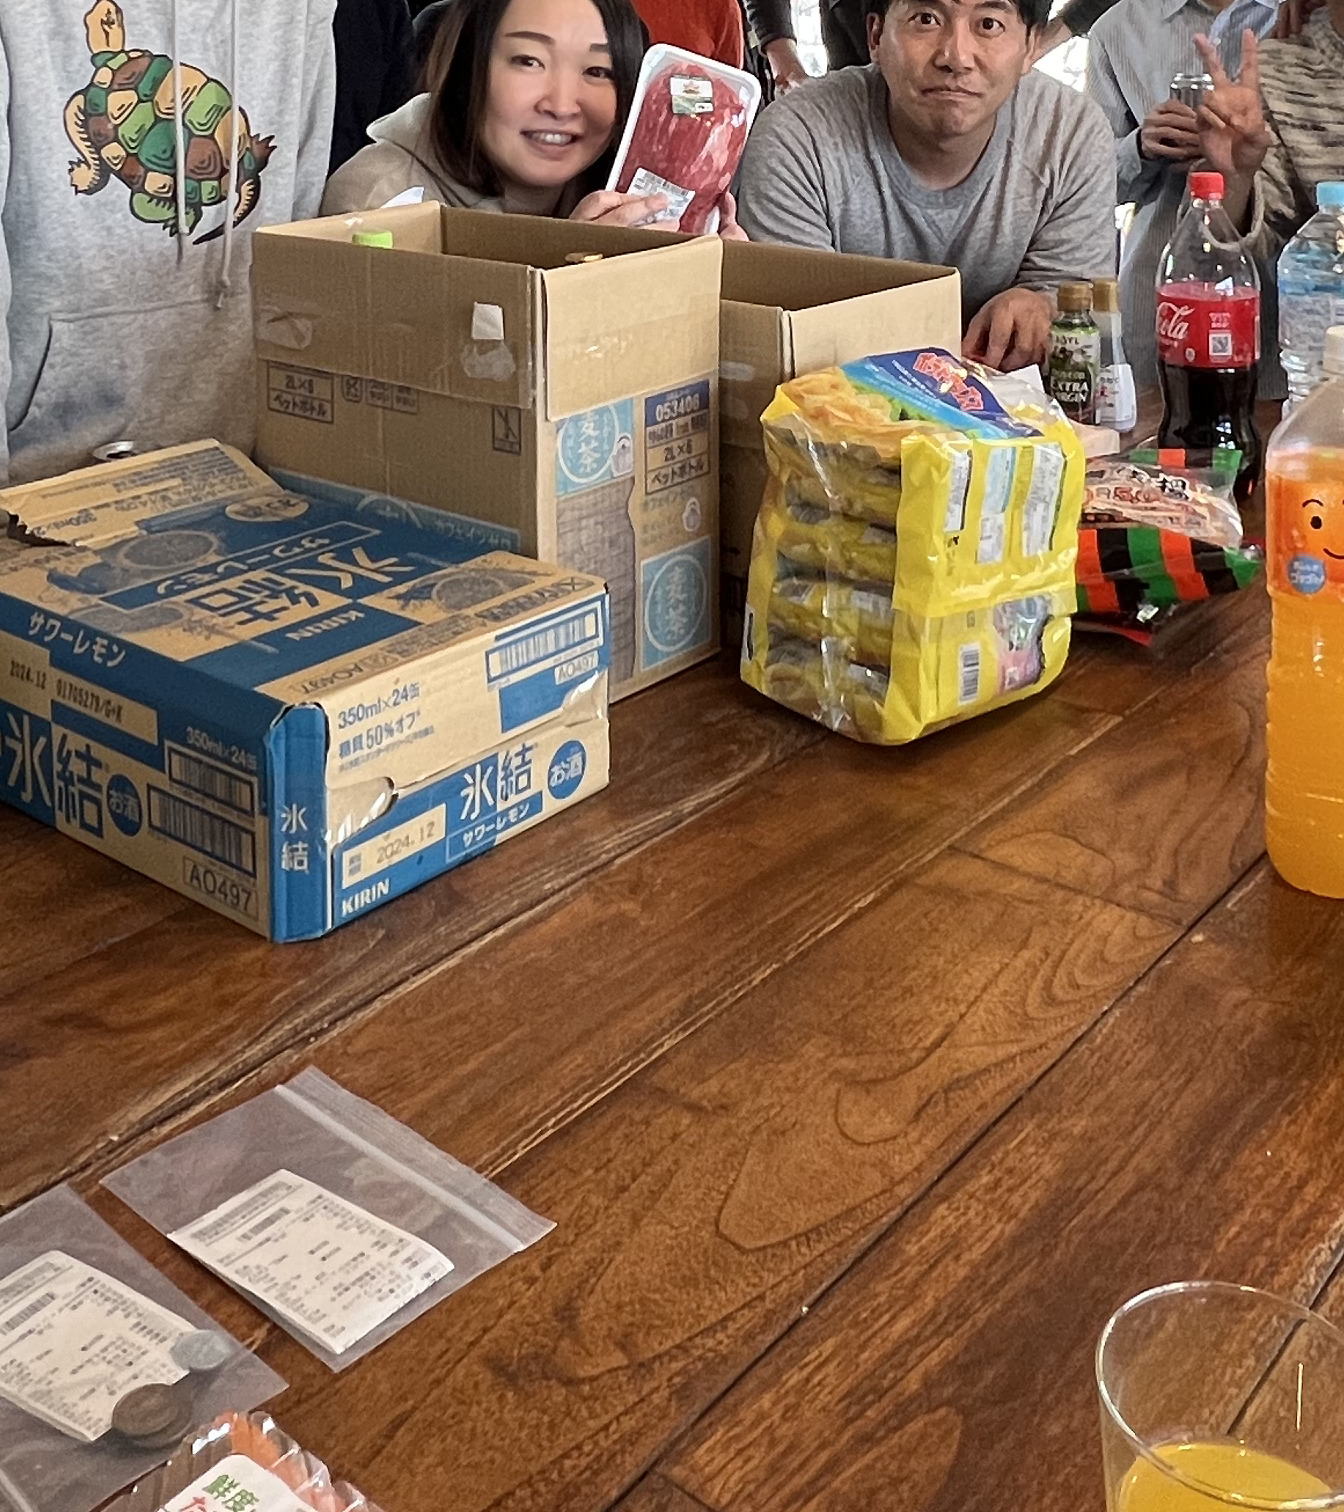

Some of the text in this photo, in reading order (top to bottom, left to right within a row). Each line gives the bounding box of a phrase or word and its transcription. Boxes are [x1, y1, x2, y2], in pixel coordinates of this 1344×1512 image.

[28, 611, 127, 668] サワーレモン
[6, 711, 105, 839] 氷結
[459, 741, 533, 821] 氷結
[549, 752, 584, 787] お酒
[109, 790, 141, 824] お酒
[462, 801, 531, 848] サワーレモン
[281, 803, 309, 875] 氷結
[376, 820, 436, 865] 2024.12
[341, 877, 391, 918] KIRIN
